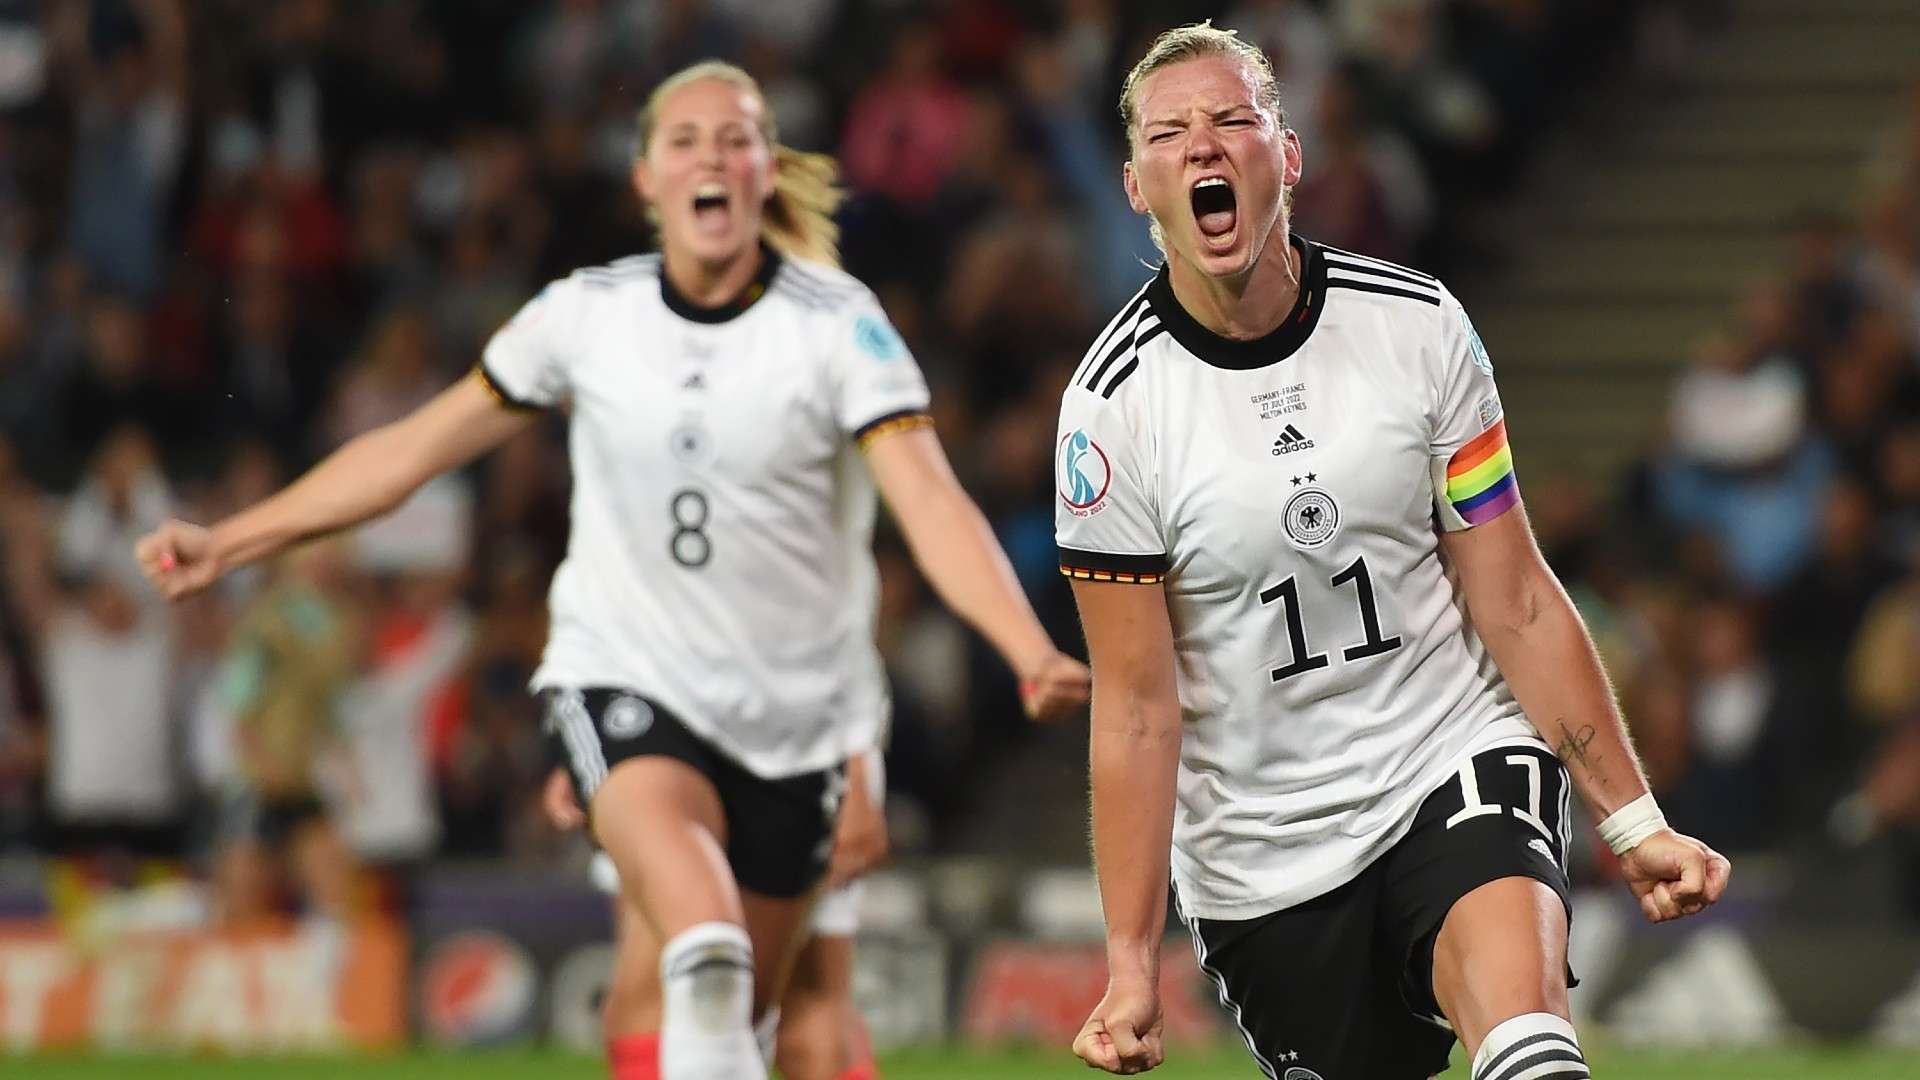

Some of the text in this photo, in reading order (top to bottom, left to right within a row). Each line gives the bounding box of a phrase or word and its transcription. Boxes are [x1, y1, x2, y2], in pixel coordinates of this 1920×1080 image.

[1250, 382, 1307, 404] GERMANY-FRANCE
[1261, 393, 1300, 411] 27 JULY 2022
[1259, 401, 1307, 420] MILTON KEYNES
[1271, 439, 1315, 456] adidas
[670, 488, 711, 569] 8
[1259, 555, 1402, 682] 11
[1446, 753, 1554, 843] 11
